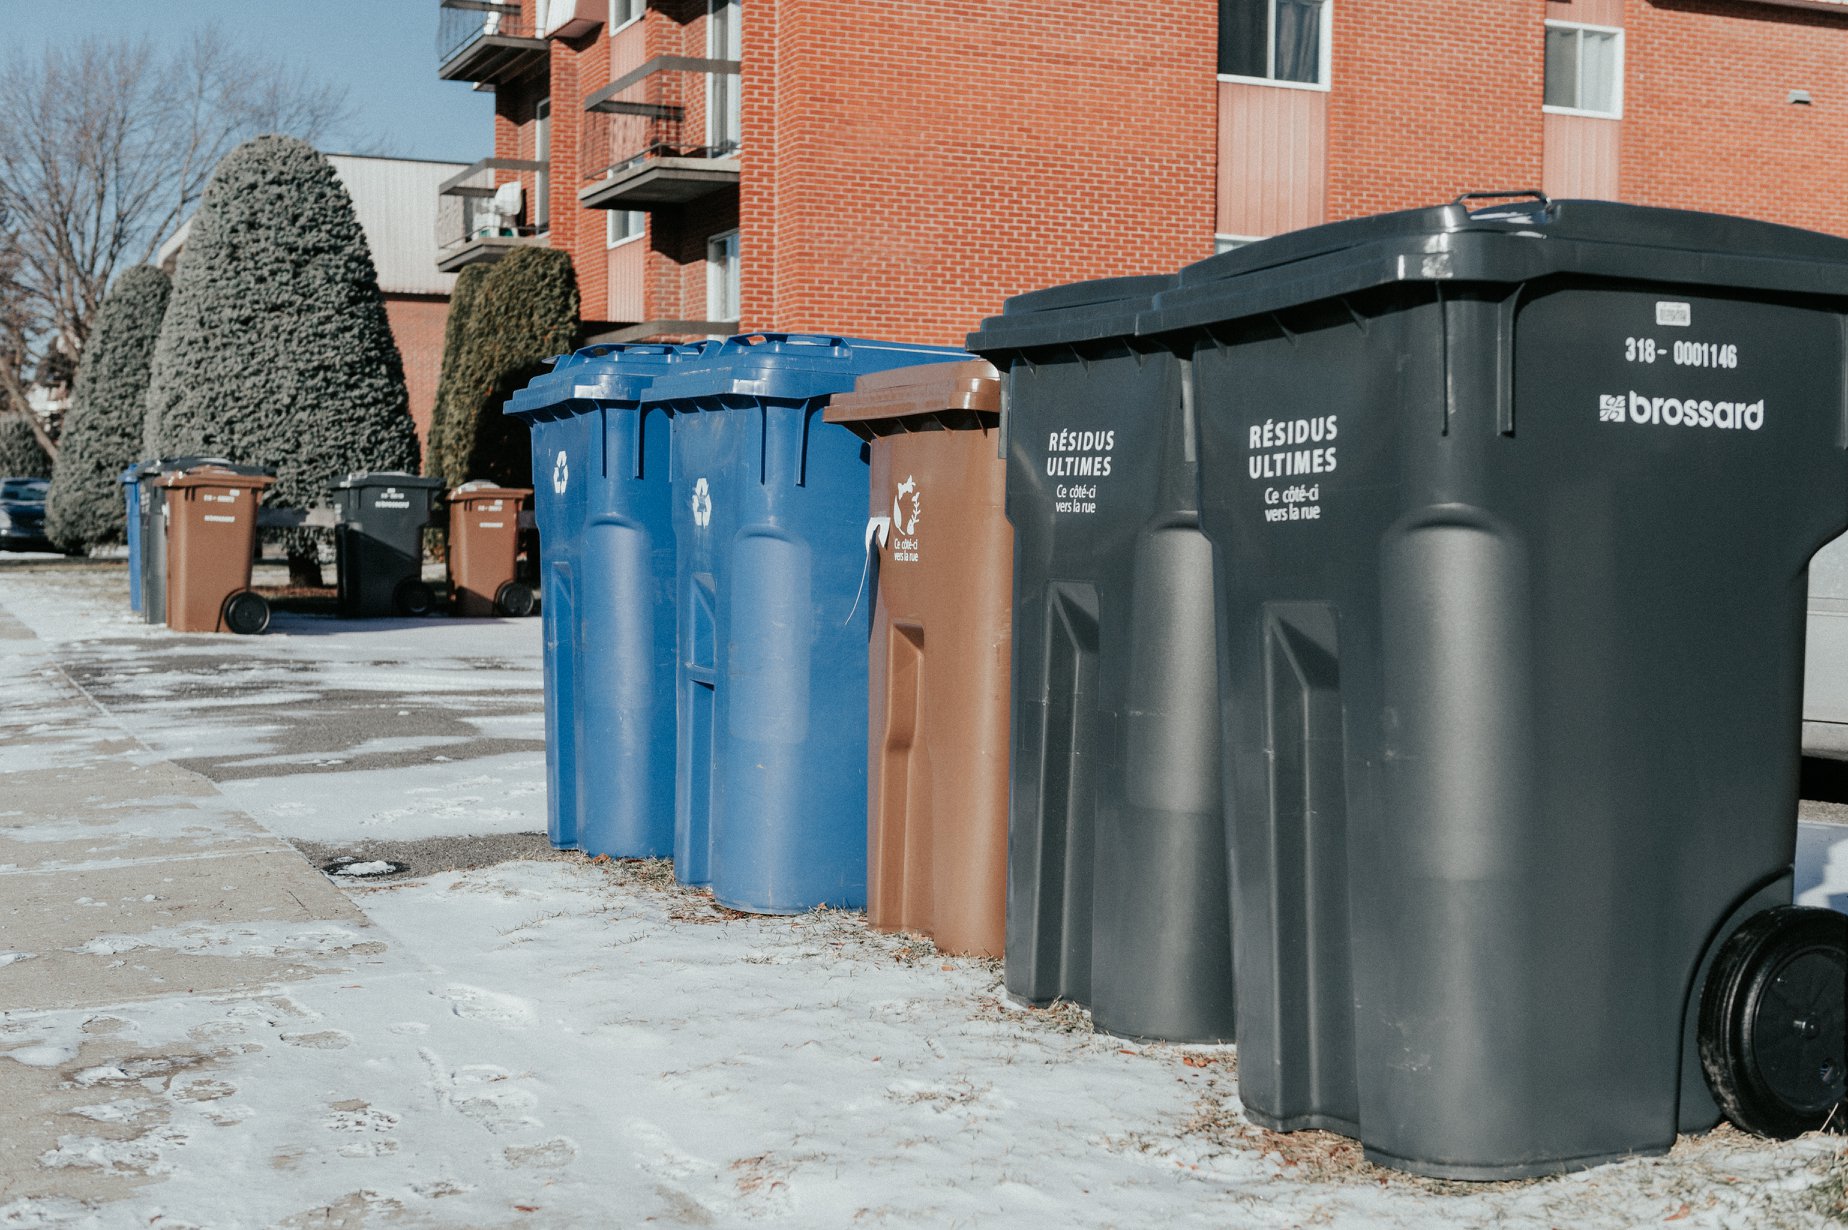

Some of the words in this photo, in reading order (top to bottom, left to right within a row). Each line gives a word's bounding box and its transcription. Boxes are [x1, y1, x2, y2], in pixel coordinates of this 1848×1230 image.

[1625, 337, 1668, 364] 318-
[1673, 340, 1738, 369] 0001146
[1629, 390, 1764, 431] brossard
[1048, 428, 1115, 451] RÉSIDUS
[1249, 415, 1338, 449] RÉSIDUS
[1046, 456, 1112, 476] ULTIMES
[1249, 447, 1337, 479] ULTIMES
[1056, 484, 1067, 498] Ce
[1069, 484, 1096, 498] côté-ci
[1264, 487, 1280, 504] Ce
[1282, 483, 1319, 503] côté-ci
[1055, 501, 1072, 513] vers
[1072, 498, 1081, 513] la
[1081, 502, 1096, 514] rue
[1264, 507, 1288, 522] vers
[1289, 503, 1300, 520] la
[1301, 505, 1321, 520] rue
[894, 538, 900, 549] Ce
[909, 552, 919, 562] rue
